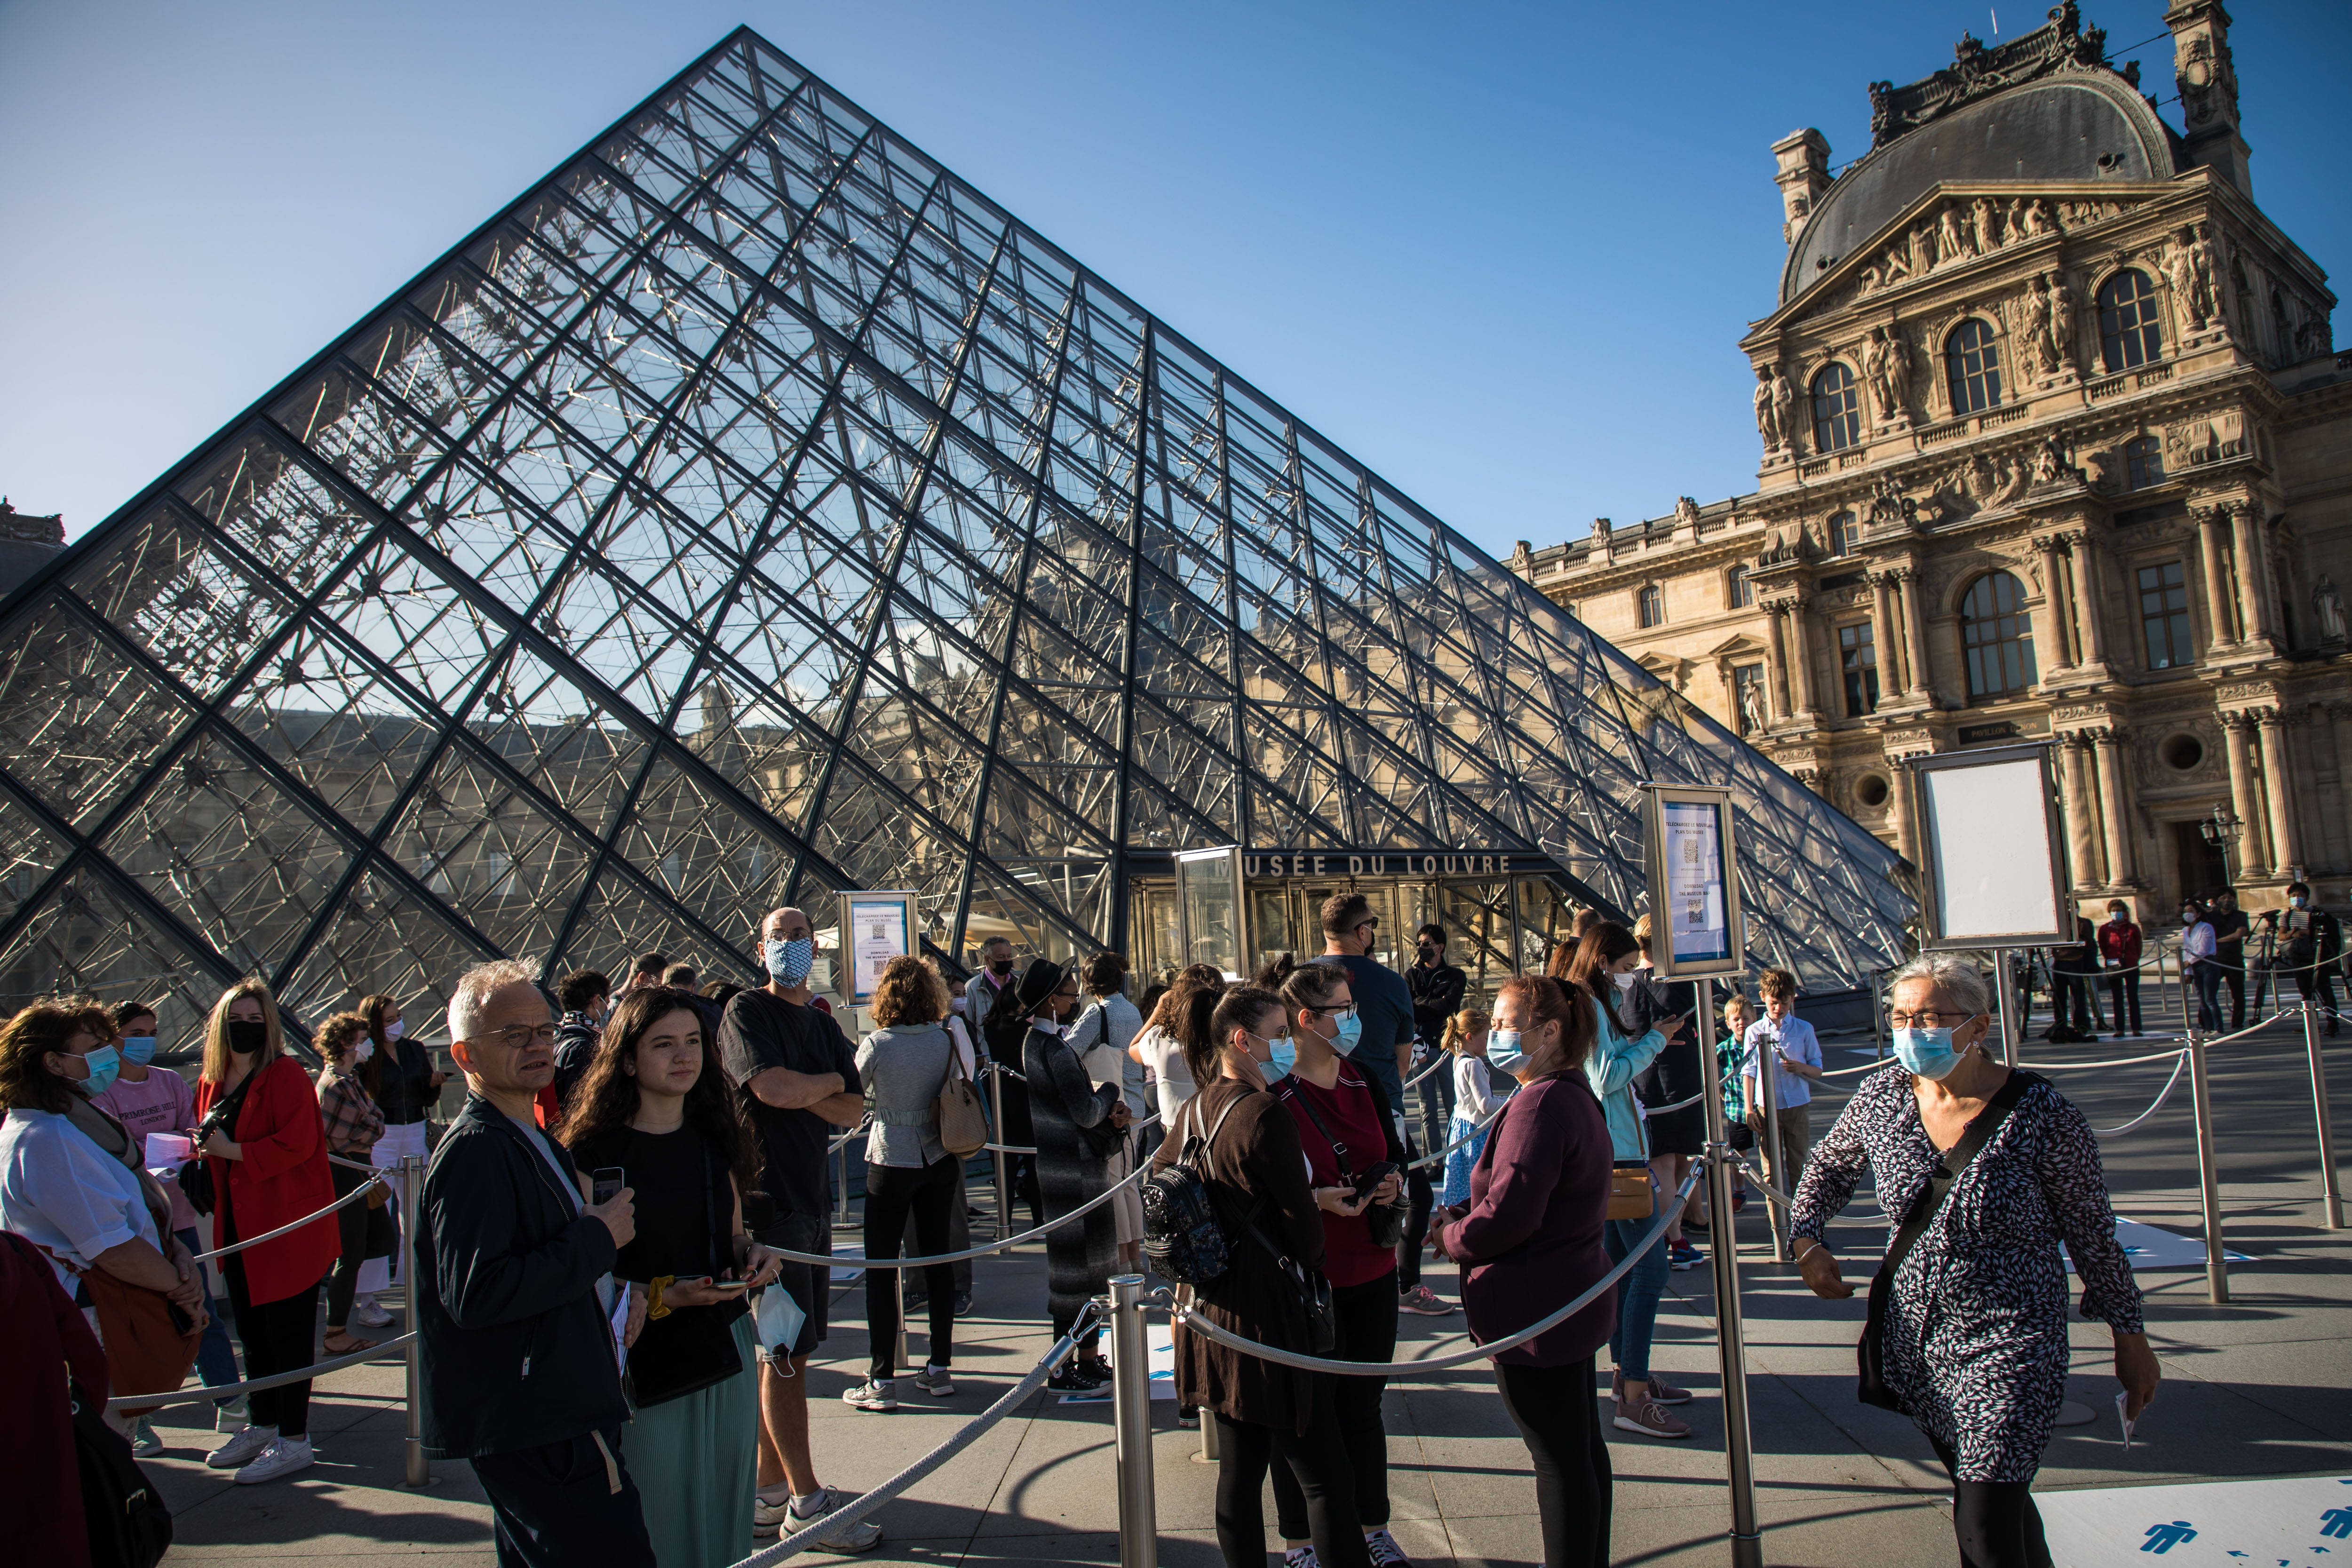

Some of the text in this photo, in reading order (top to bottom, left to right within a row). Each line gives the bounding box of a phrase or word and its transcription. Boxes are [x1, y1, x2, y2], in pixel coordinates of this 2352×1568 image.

[1972, 726, 2006, 738] PAVILLON
[1350, 856, 1386, 875] DU
[1407, 855, 1510, 875] LOUVRE
[119, 1101, 177, 1120] PRIMROSE HILL
[140, 1114, 167, 1126] LONDON
